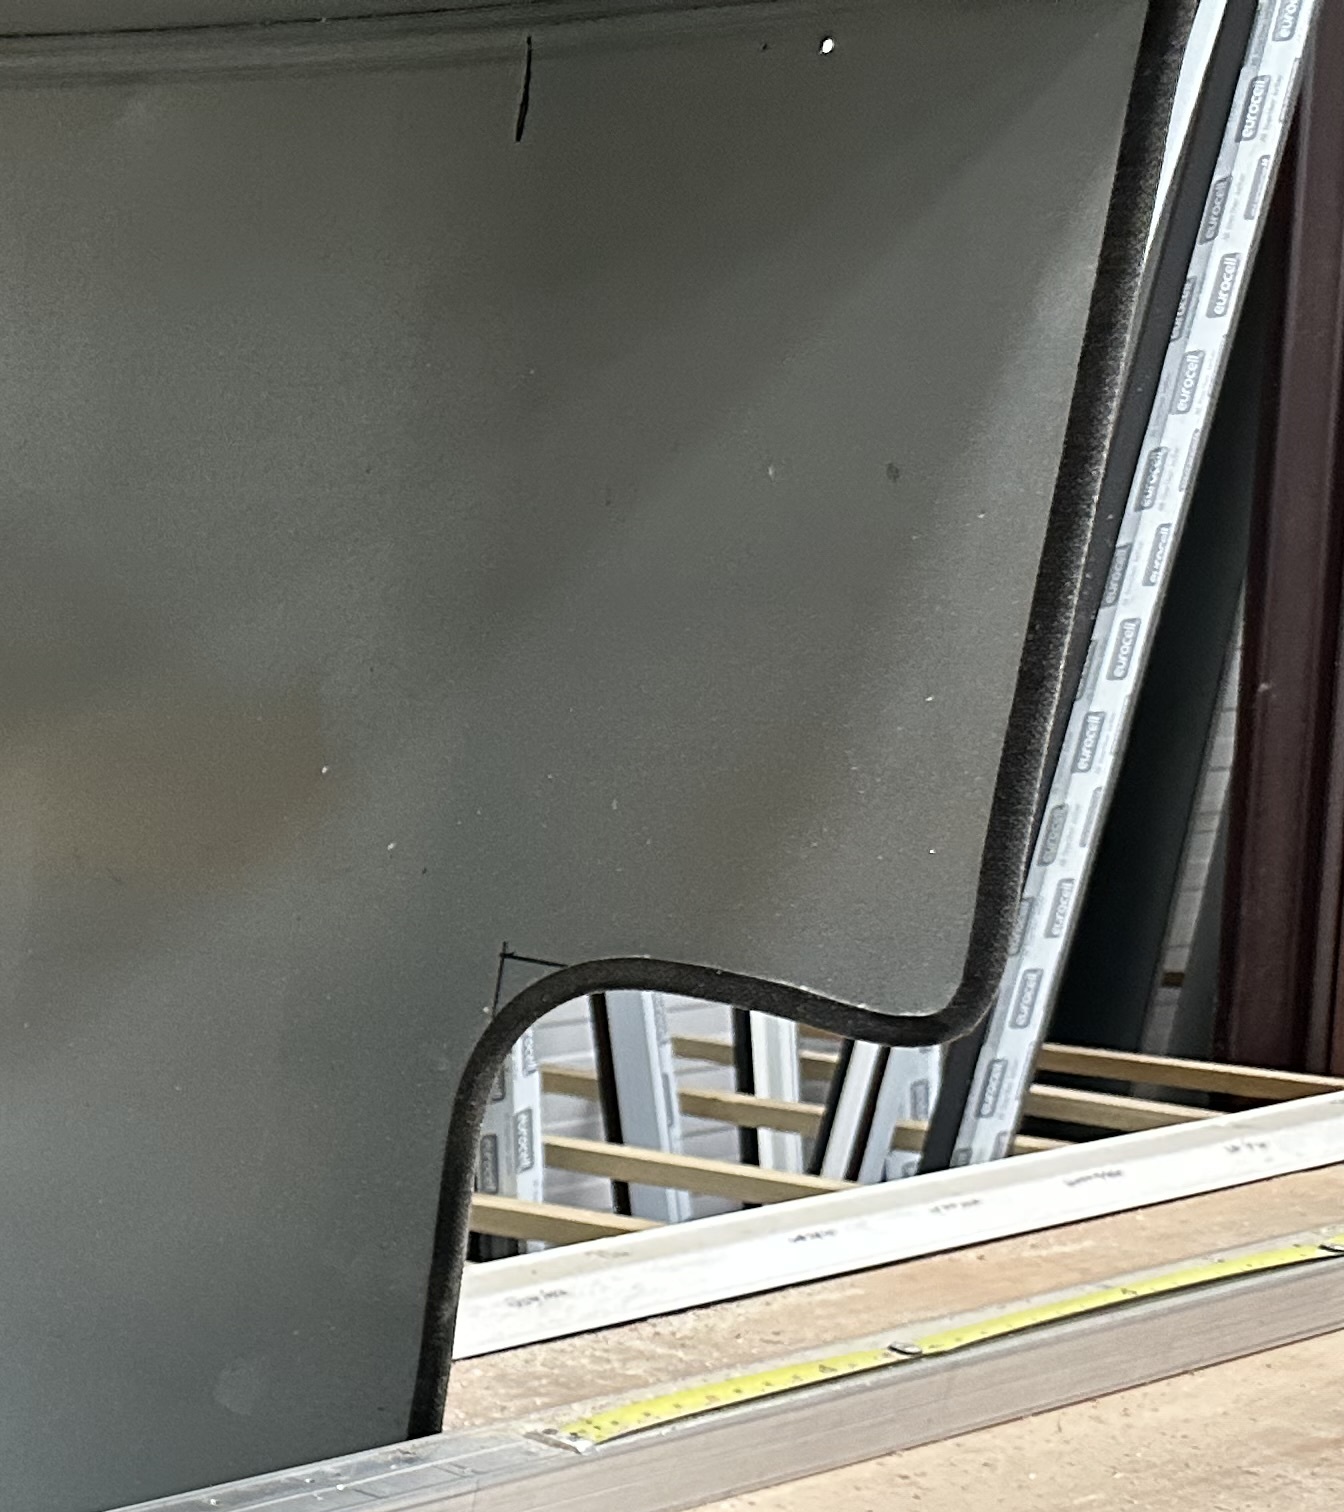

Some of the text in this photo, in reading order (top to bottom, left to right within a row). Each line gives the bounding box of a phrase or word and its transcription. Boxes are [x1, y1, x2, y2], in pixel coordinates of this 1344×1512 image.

[1279, 0, 1298, 38] euro
[1241, 80, 1266, 138] eurocell
[1213, 257, 1237, 315] eurocell
[1177, 355, 1199, 411] eurocell
[1114, 622, 1136, 677] eurocell
[1077, 716, 1101, 769] eurocell
